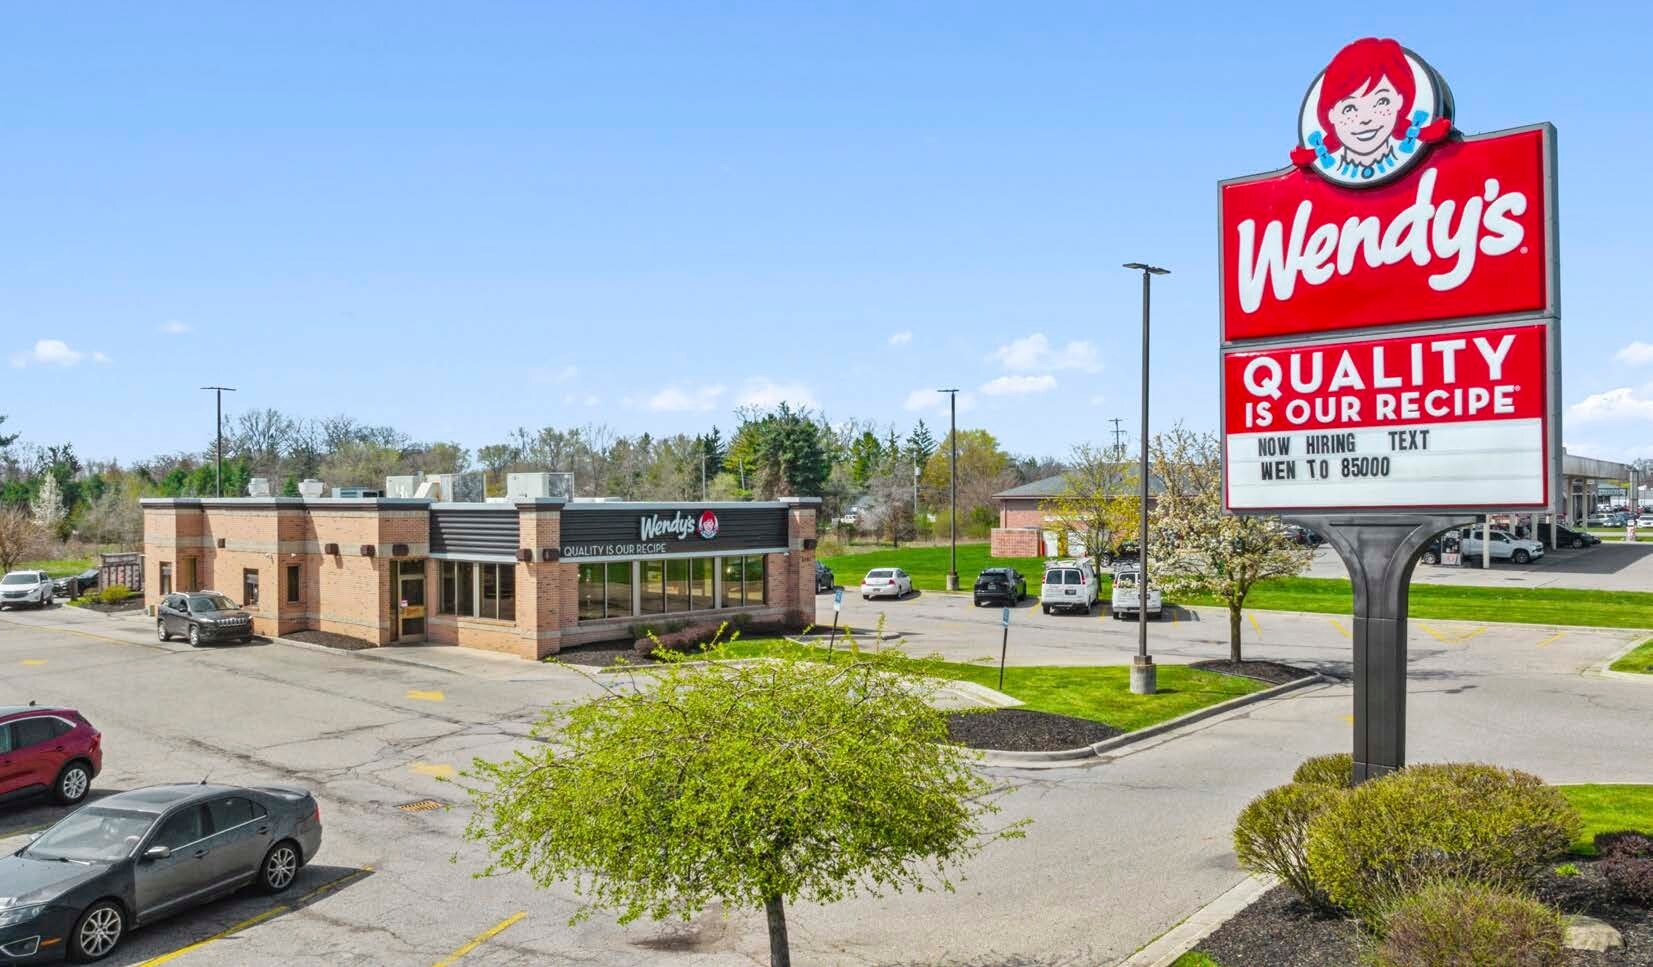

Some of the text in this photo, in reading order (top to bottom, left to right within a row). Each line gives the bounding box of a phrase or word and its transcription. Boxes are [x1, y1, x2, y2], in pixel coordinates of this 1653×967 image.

[1238, 168, 1527, 314] Wendy's
[1243, 335, 1516, 400] QUALITY
[1245, 385, 1515, 427] IS OUR RECIPE
[1258, 429, 1430, 457] NOW HIRING TEXT
[1261, 456, 1390, 481] WEN TO 85000
[640, 511, 695, 541] Wendy's
[563, 543, 667, 557] QUALITY IS OUR RECIPE
